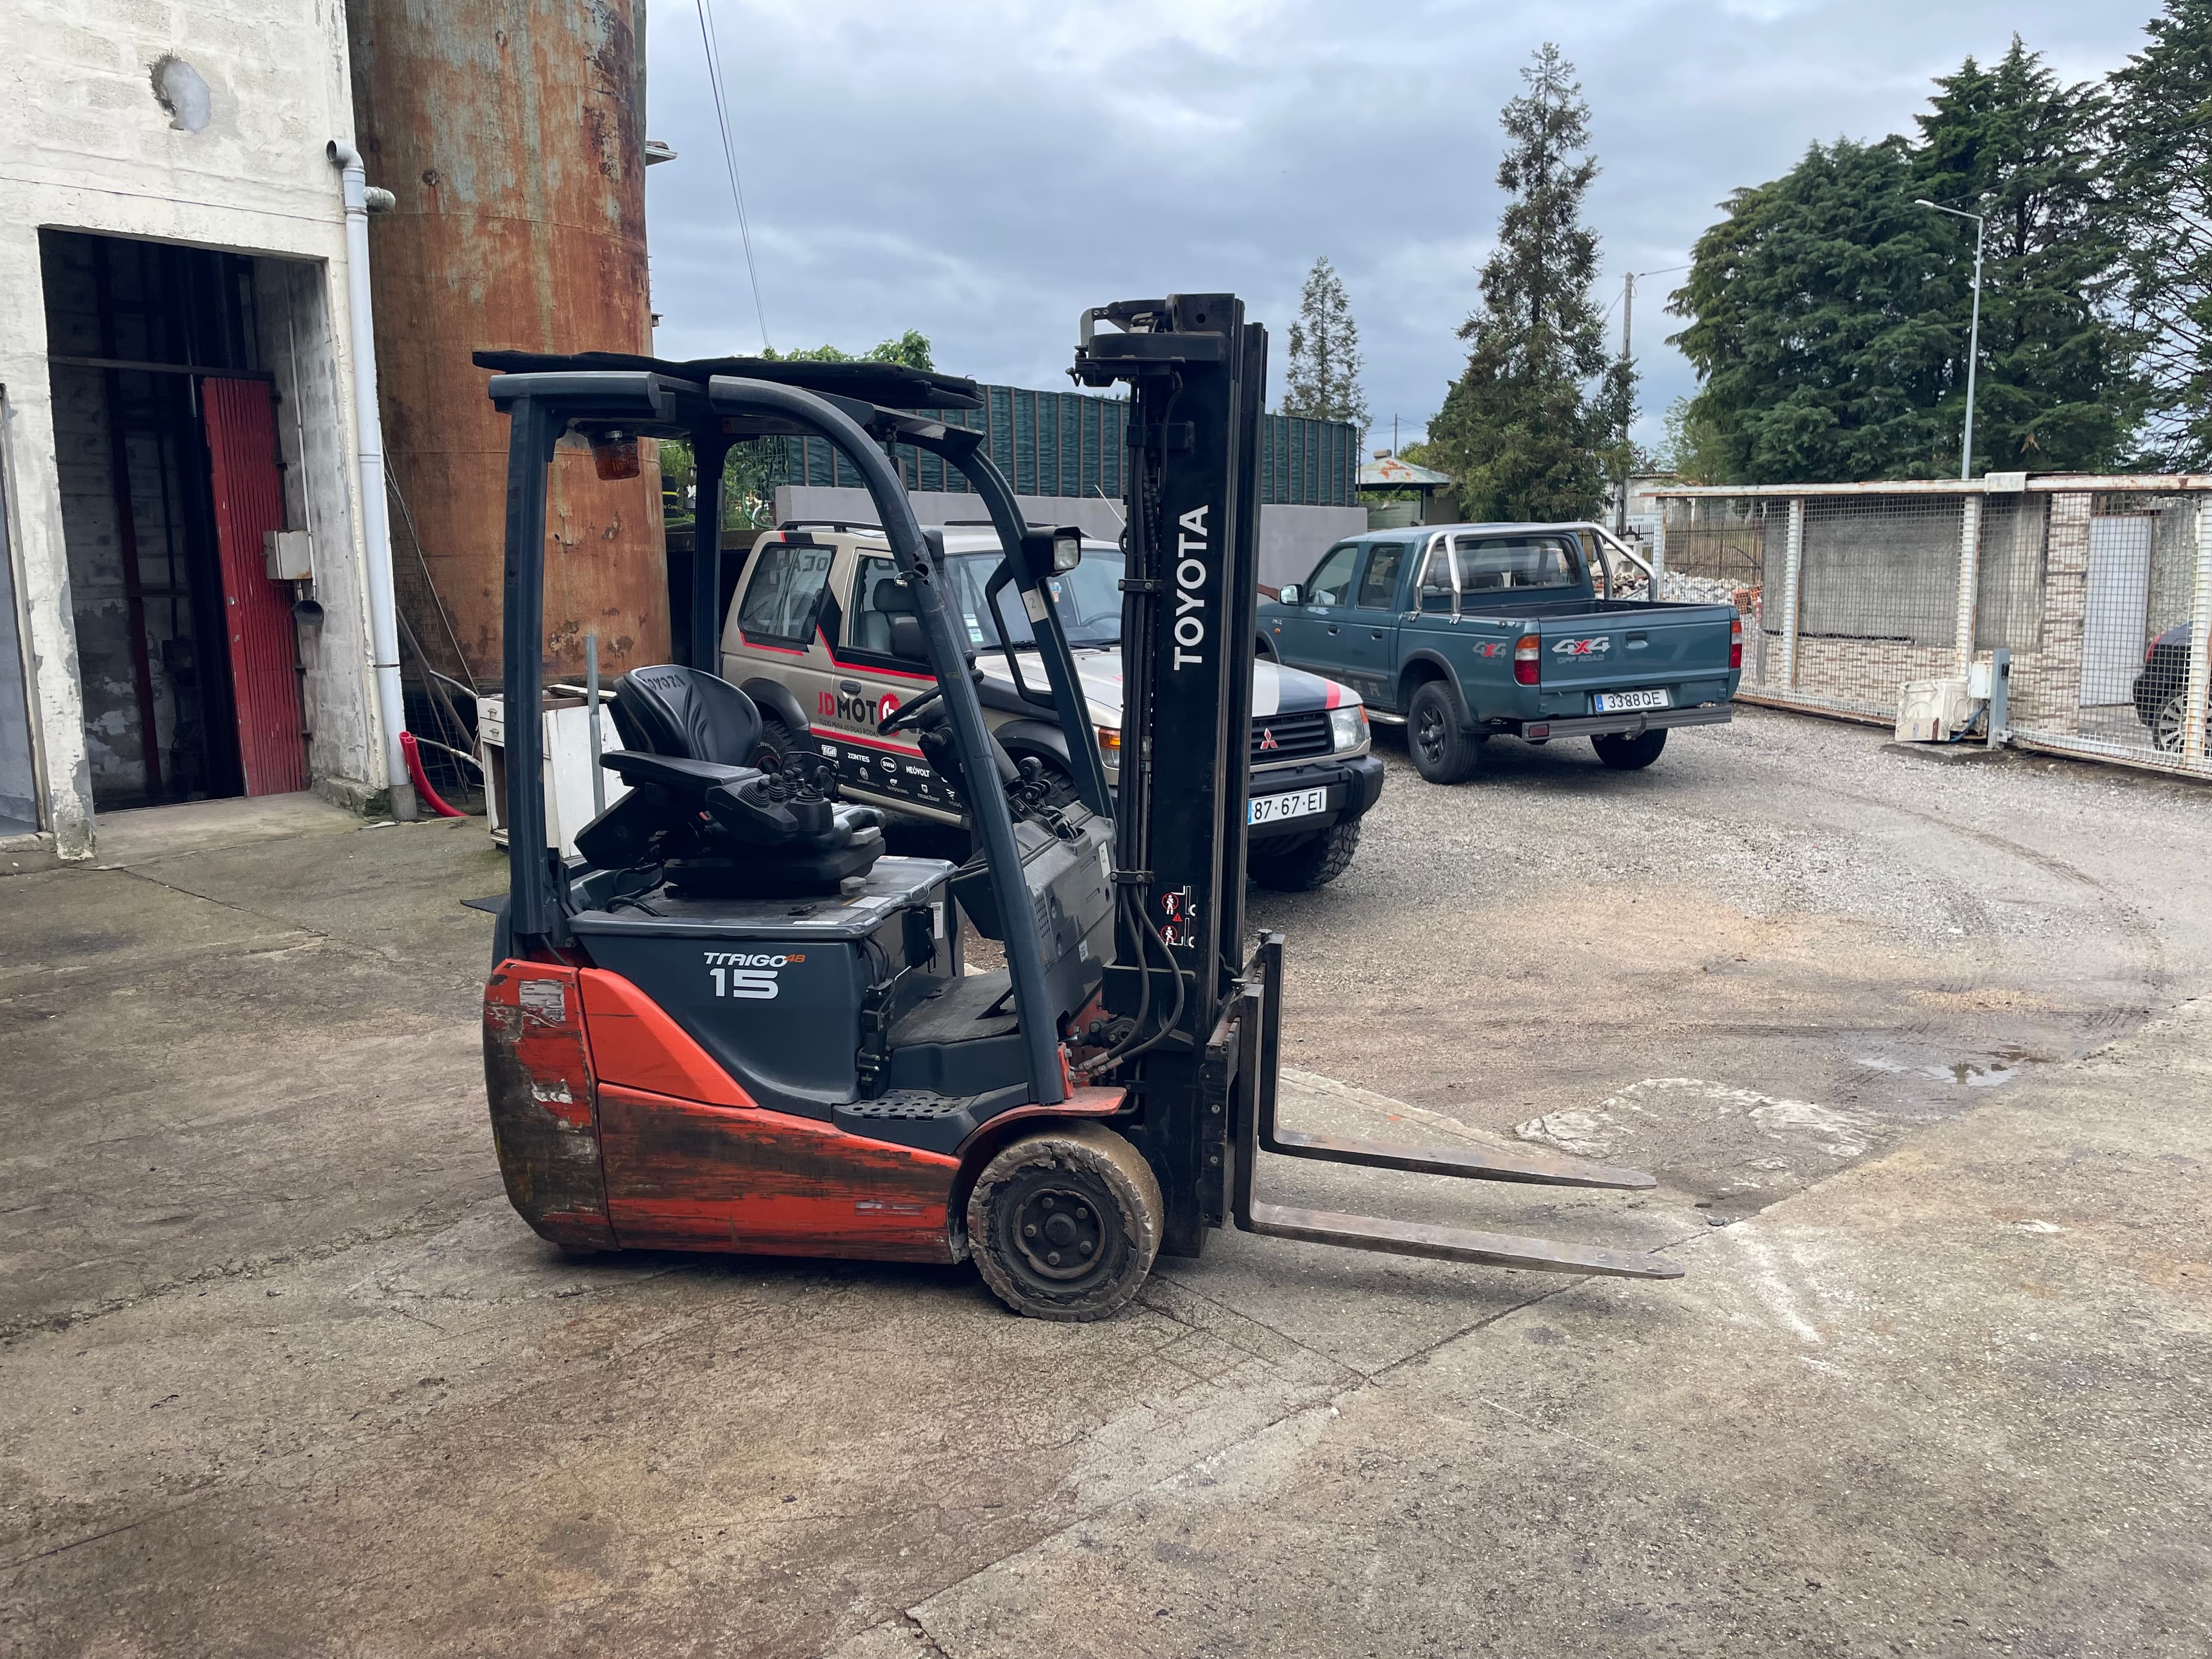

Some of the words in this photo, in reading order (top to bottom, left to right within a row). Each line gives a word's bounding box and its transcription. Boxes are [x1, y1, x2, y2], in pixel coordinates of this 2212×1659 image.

[1173, 504, 1209, 671] TOYOTA
[1029, 597, 1036, 609] 2
[821, 744, 838, 757] TGB
[847, 752, 870, 763] ZONTES
[709, 968, 779, 999] 15
